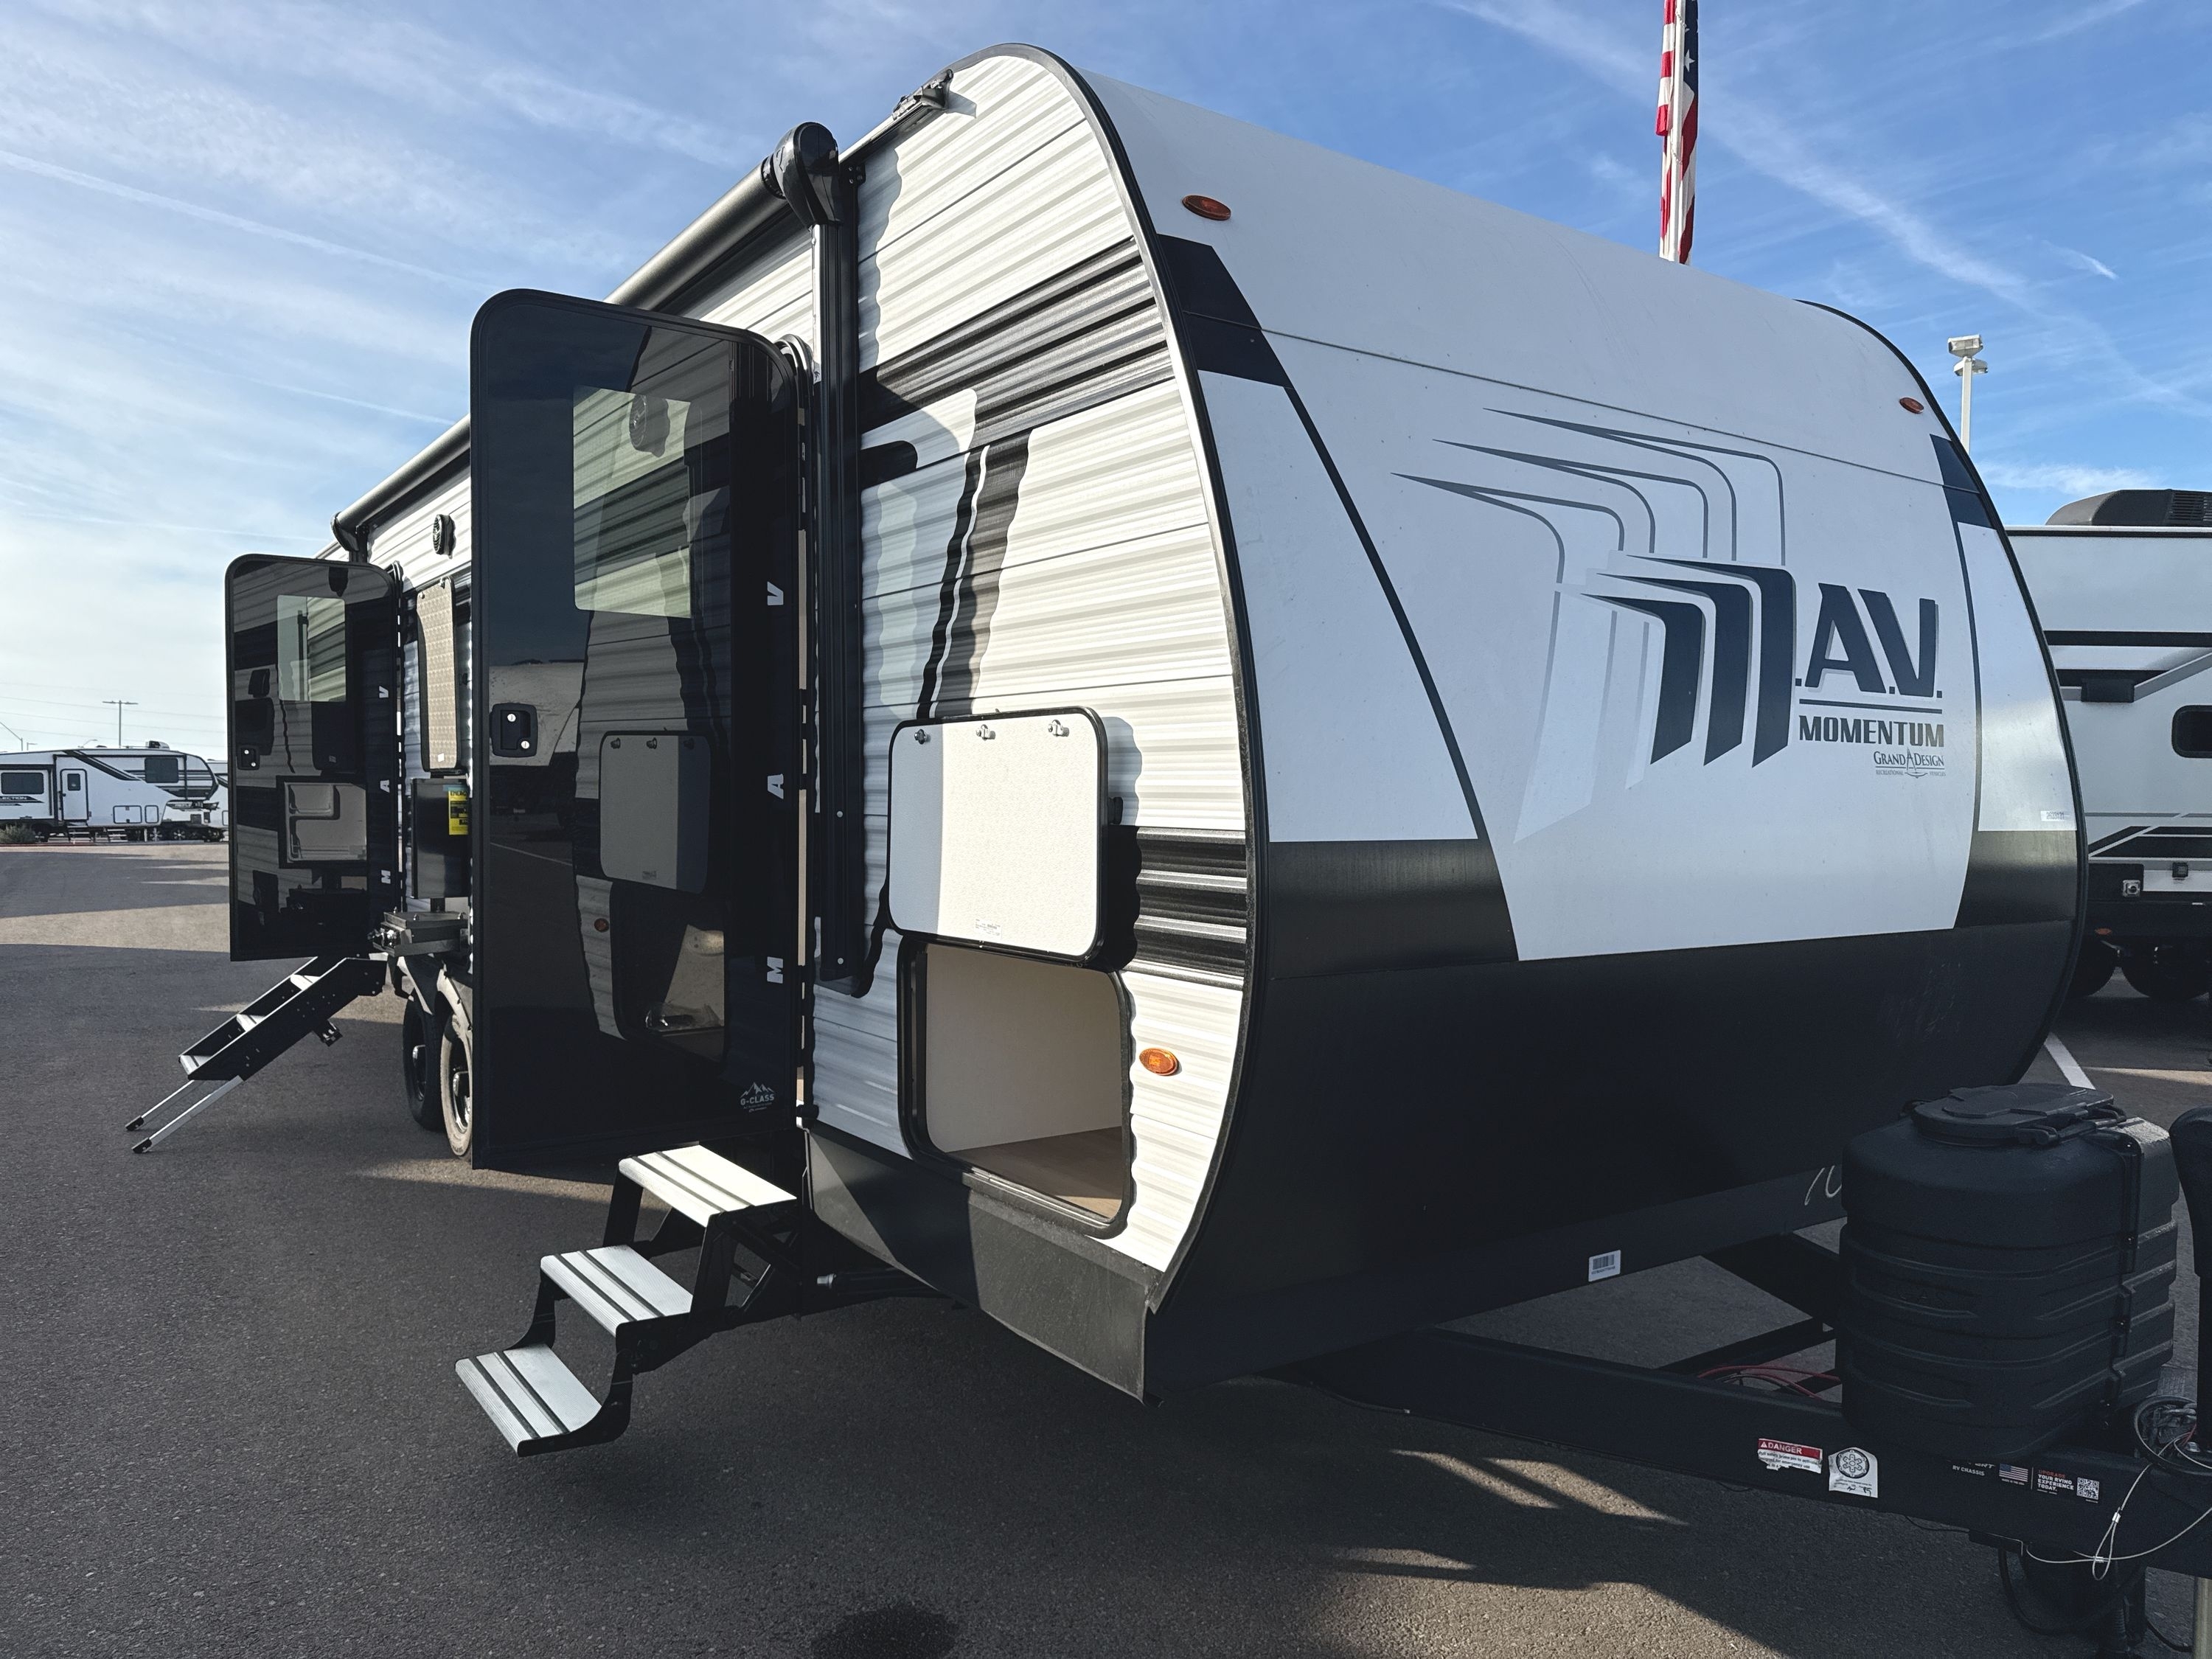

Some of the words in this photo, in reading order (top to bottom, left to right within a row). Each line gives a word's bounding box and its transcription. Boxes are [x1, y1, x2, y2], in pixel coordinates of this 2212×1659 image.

[1798, 714, 1944, 748] MOMENTUM
[1913, 752, 1945, 767] DESIGN
[740, 1093, 775, 1106] G-CLASS
[1767, 1442, 1803, 1455] DANGER
[1961, 1467, 1985, 1476] CHASSIS
[2038, 1470, 2066, 1479] UPGRADE
[2037, 1478, 2074, 1490] EXPERIENCE
[2054, 1477, 2073, 1485] RVING
[2037, 1483, 2057, 1492] TODAY.
